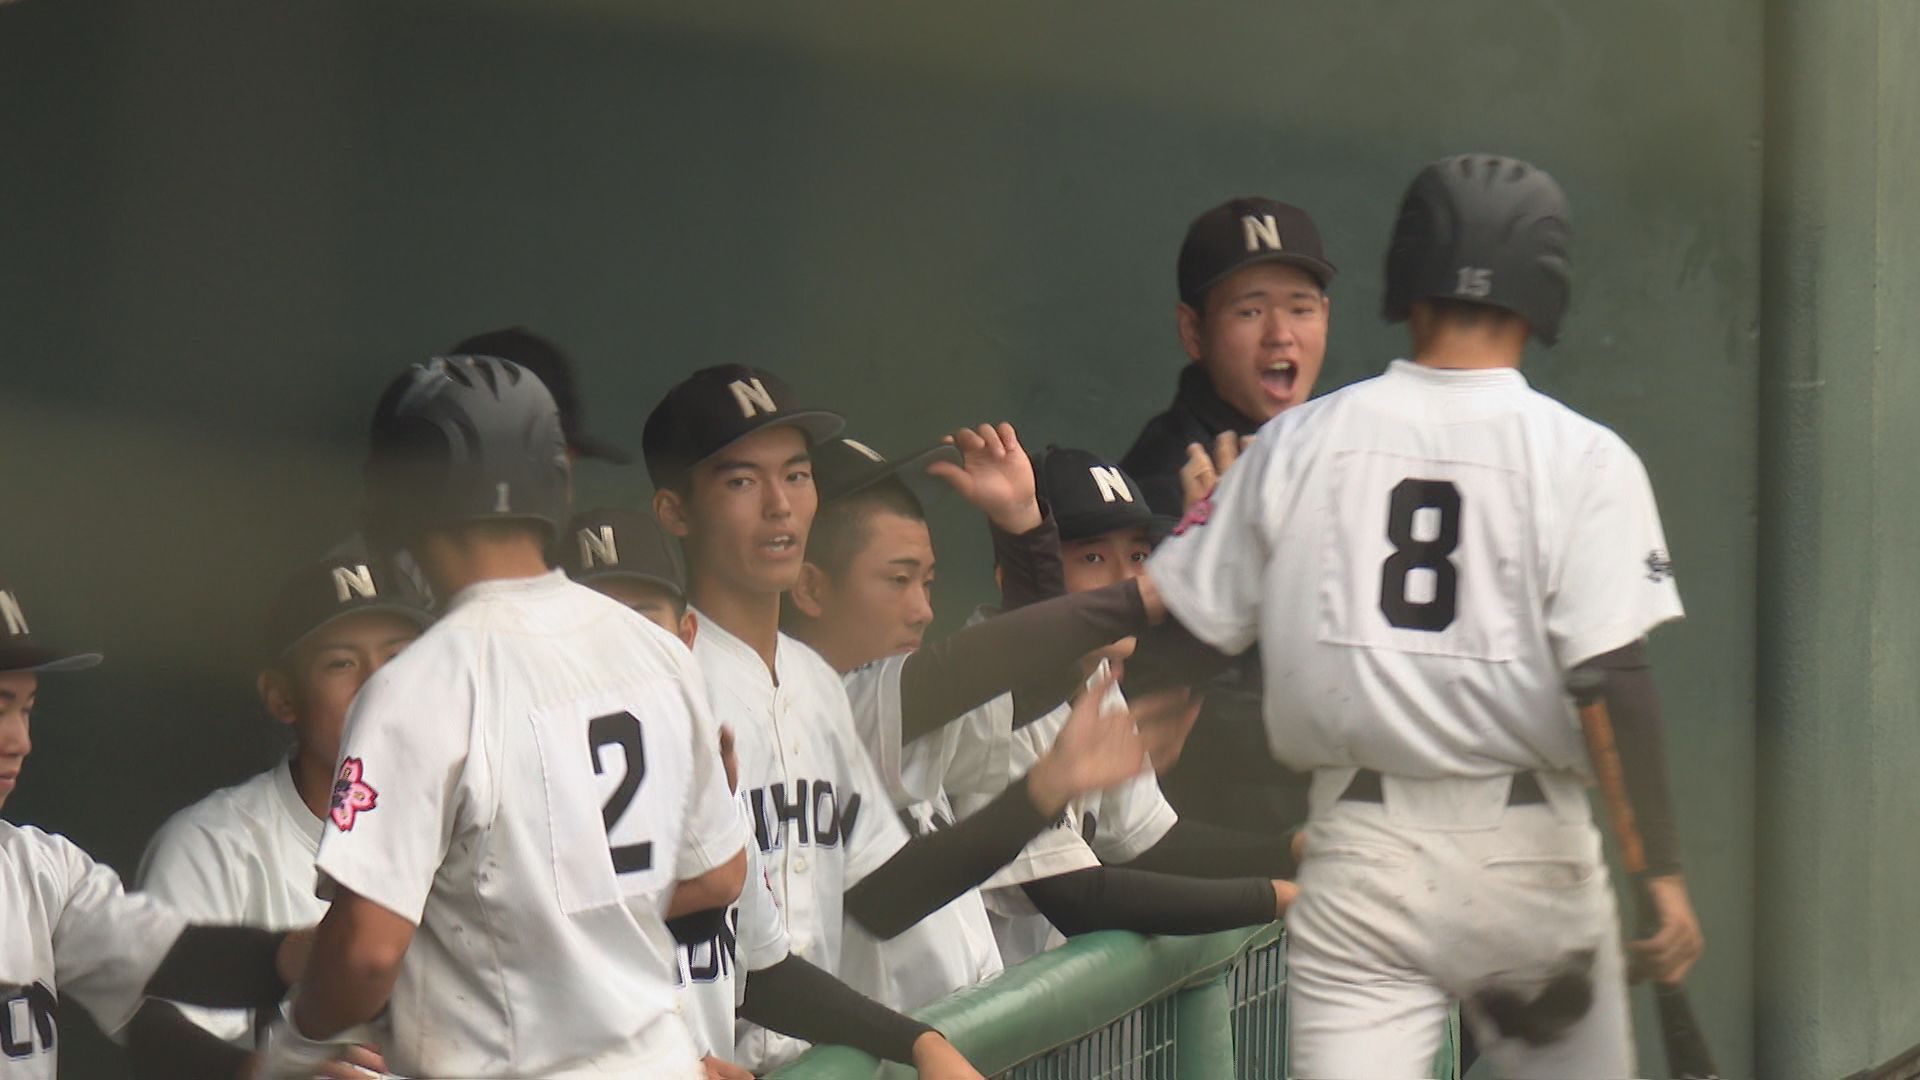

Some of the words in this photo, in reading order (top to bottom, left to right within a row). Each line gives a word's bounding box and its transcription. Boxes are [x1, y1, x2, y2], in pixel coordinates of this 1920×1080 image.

[1241, 214, 1283, 252] N
[1457, 266, 1494, 297] 15
[728, 376, 778, 419] N
[1089, 465, 1134, 503] N
[577, 525, 620, 570] N
[1379, 476, 1461, 633] 8
[332, 564, 378, 603] N
[588, 709, 656, 875] 2
